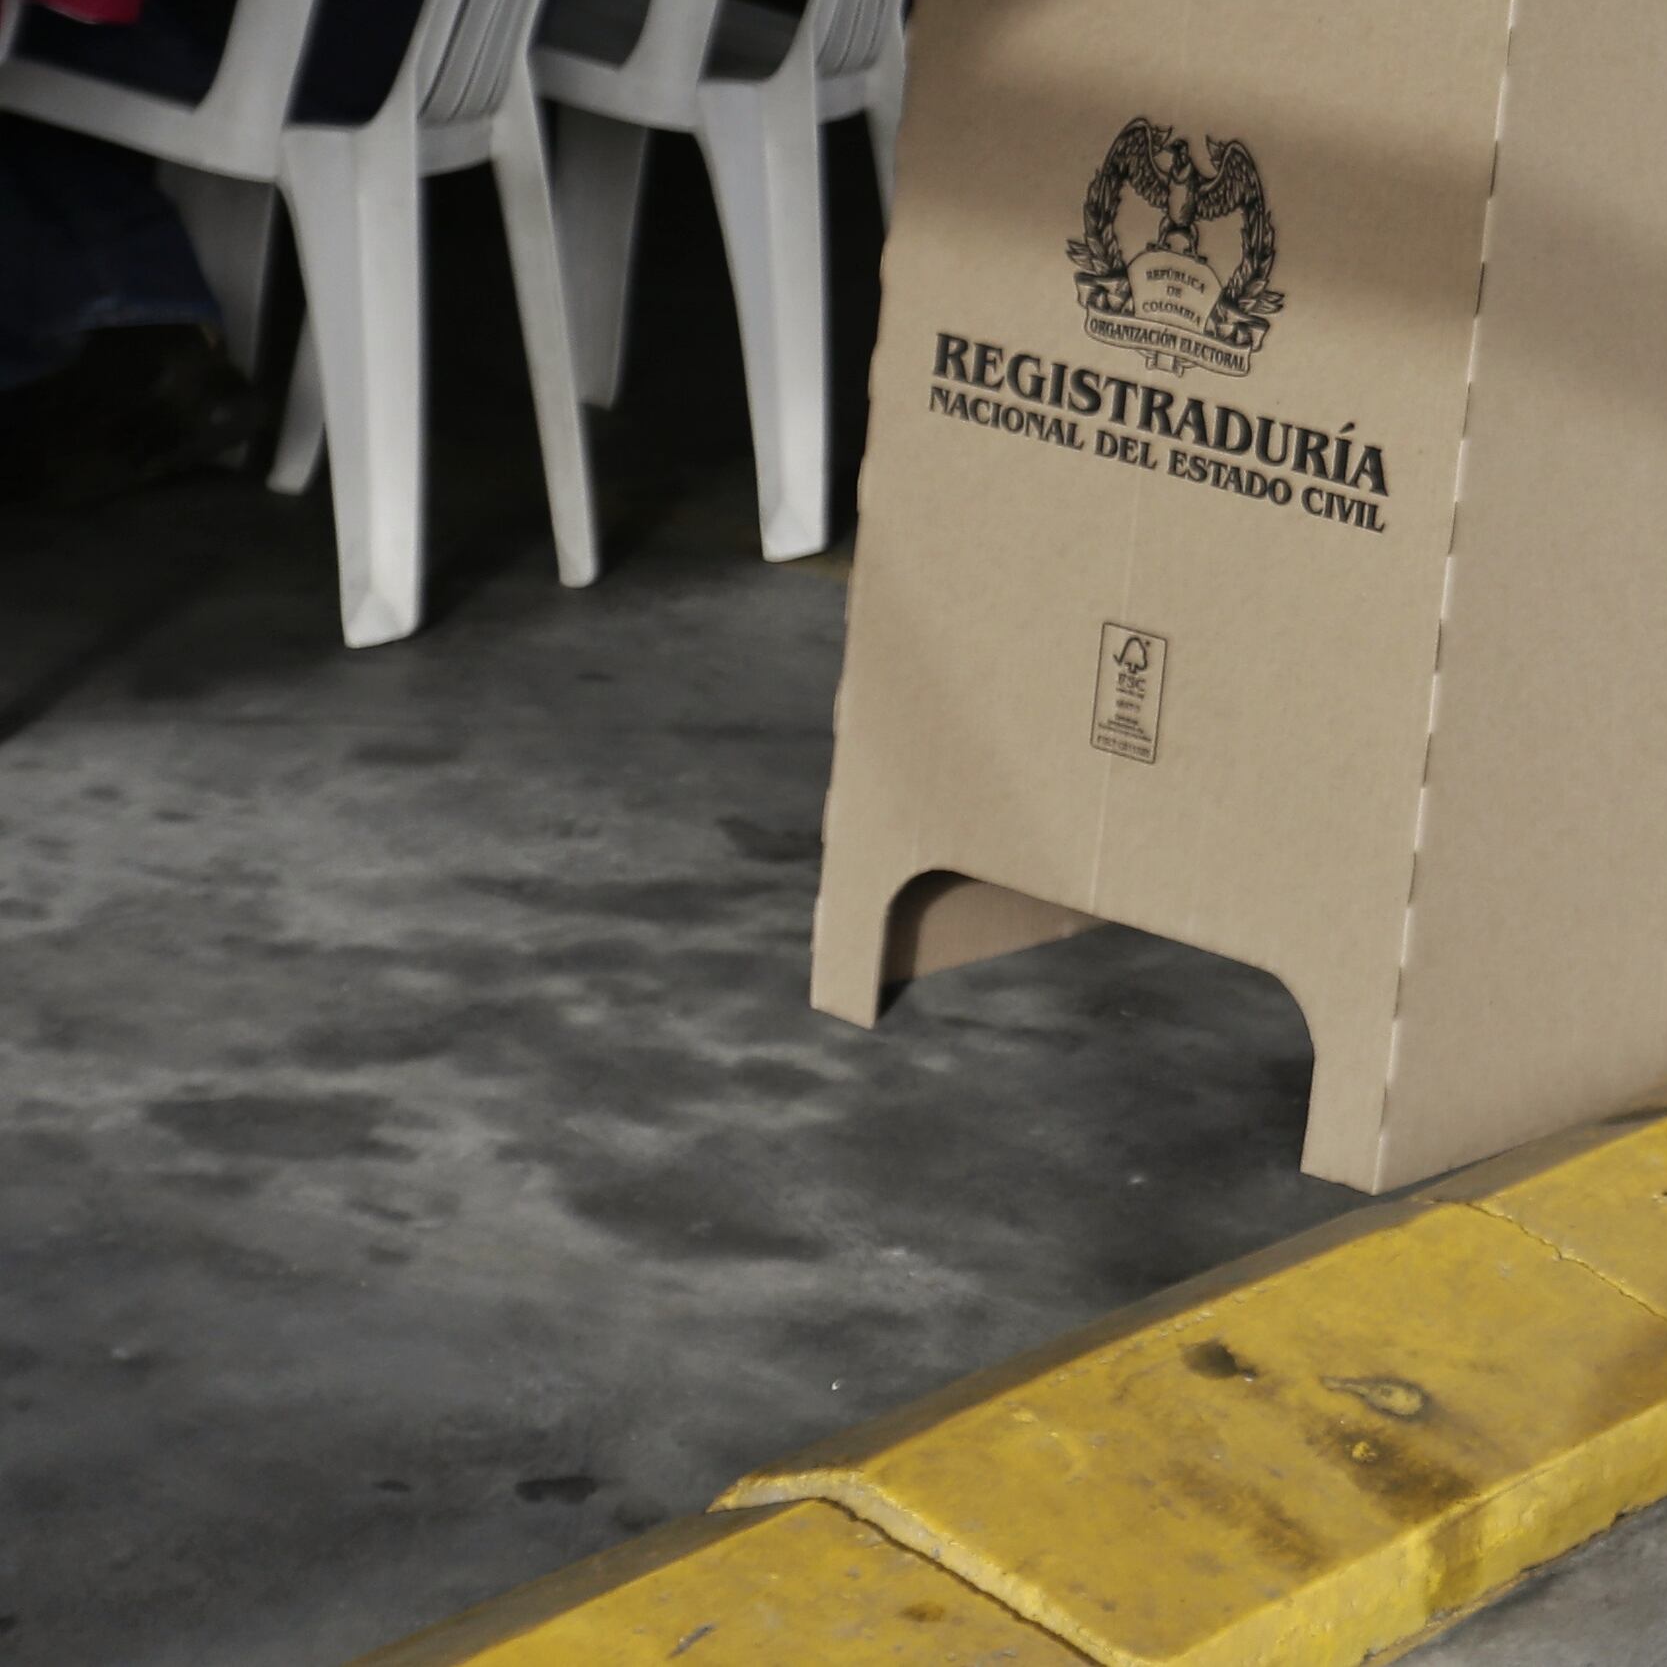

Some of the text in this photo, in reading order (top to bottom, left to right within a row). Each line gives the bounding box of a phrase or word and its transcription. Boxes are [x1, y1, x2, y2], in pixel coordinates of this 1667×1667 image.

[1145, 268, 1206, 294] REPÚBLICA
[1166, 285, 1183, 299] DE
[1142, 301, 1201, 326] COLOMBIA
[1090, 318, 1246, 371] ORGANIZACIÓN ELECTORAL
[932, 332, 1389, 497] REGISTRADURÍA
[929, 386, 1386, 534] NACIONAL DEL ESTADO CIVIL
